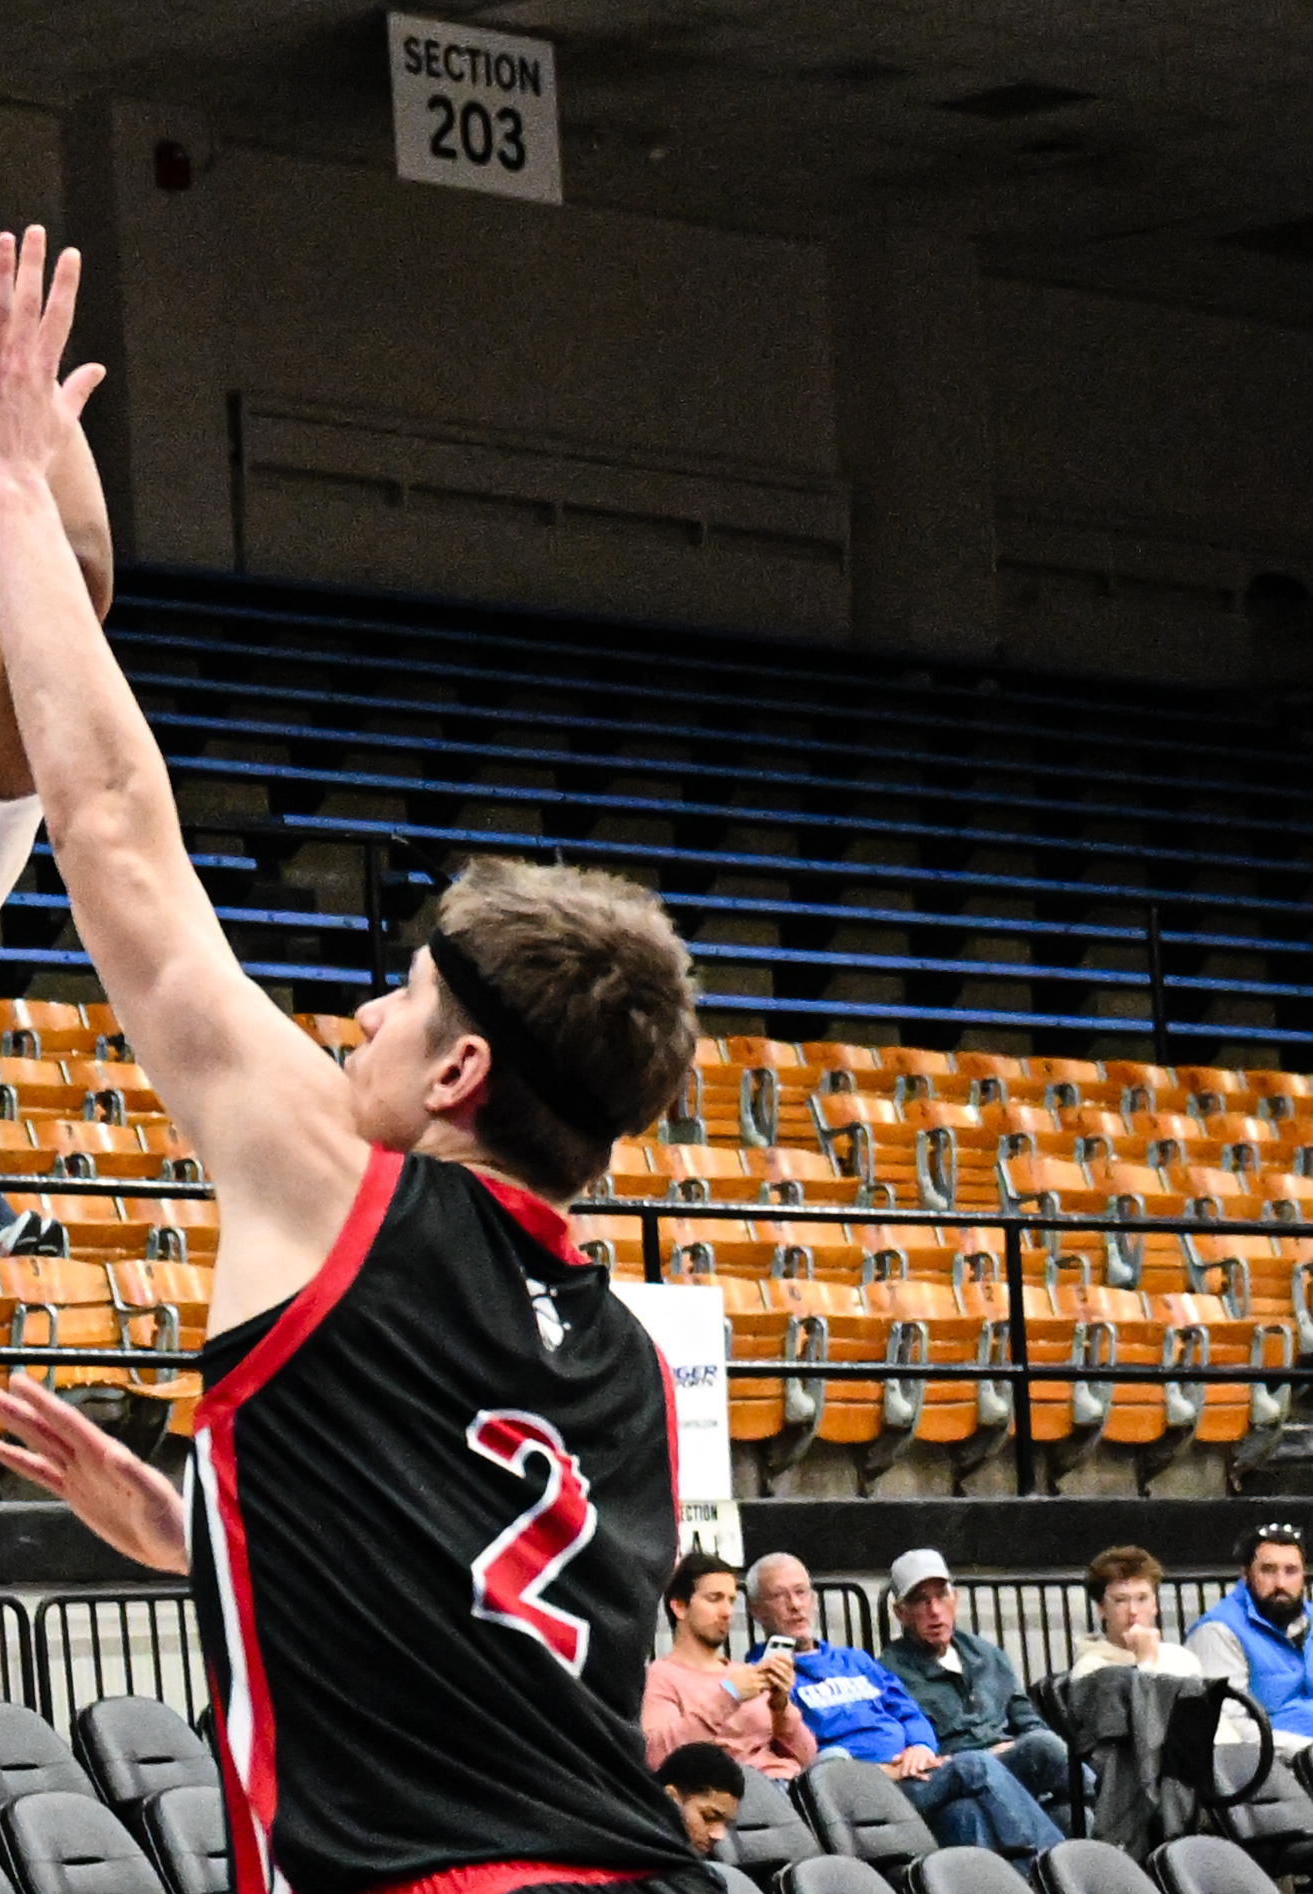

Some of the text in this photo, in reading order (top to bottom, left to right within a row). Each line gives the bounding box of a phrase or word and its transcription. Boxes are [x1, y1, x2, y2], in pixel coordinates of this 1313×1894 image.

[403, 36, 541, 97] SECTION
[427, 93, 526, 172] 203
[466, 1408, 598, 1680] 2
[680, 1505, 718, 1521] ECTION
